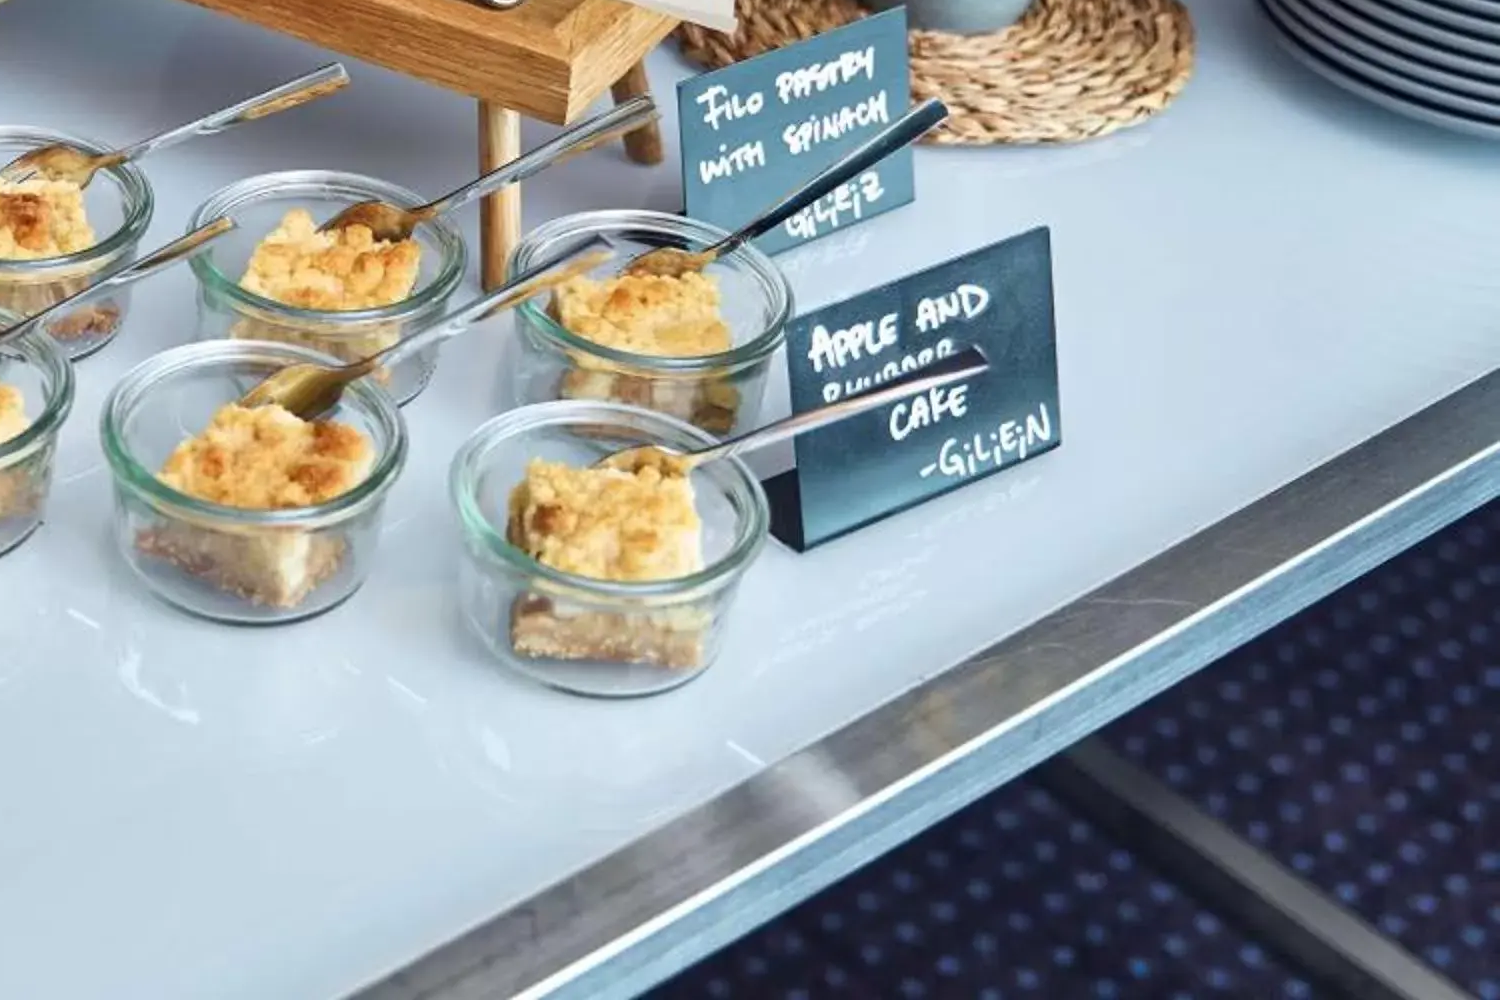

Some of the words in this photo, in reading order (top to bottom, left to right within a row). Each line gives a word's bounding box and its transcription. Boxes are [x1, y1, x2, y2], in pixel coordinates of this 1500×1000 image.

[695, 84, 765, 130] FILO
[775, 46, 875, 104] PASTRY
[699, 140, 765, 184] WITH
[782, 90, 889, 154] SPINACH
[808, 312, 899, 372] APPLE
[915, 283, 990, 331] AND
[889, 384, 969, 441] CAKE
